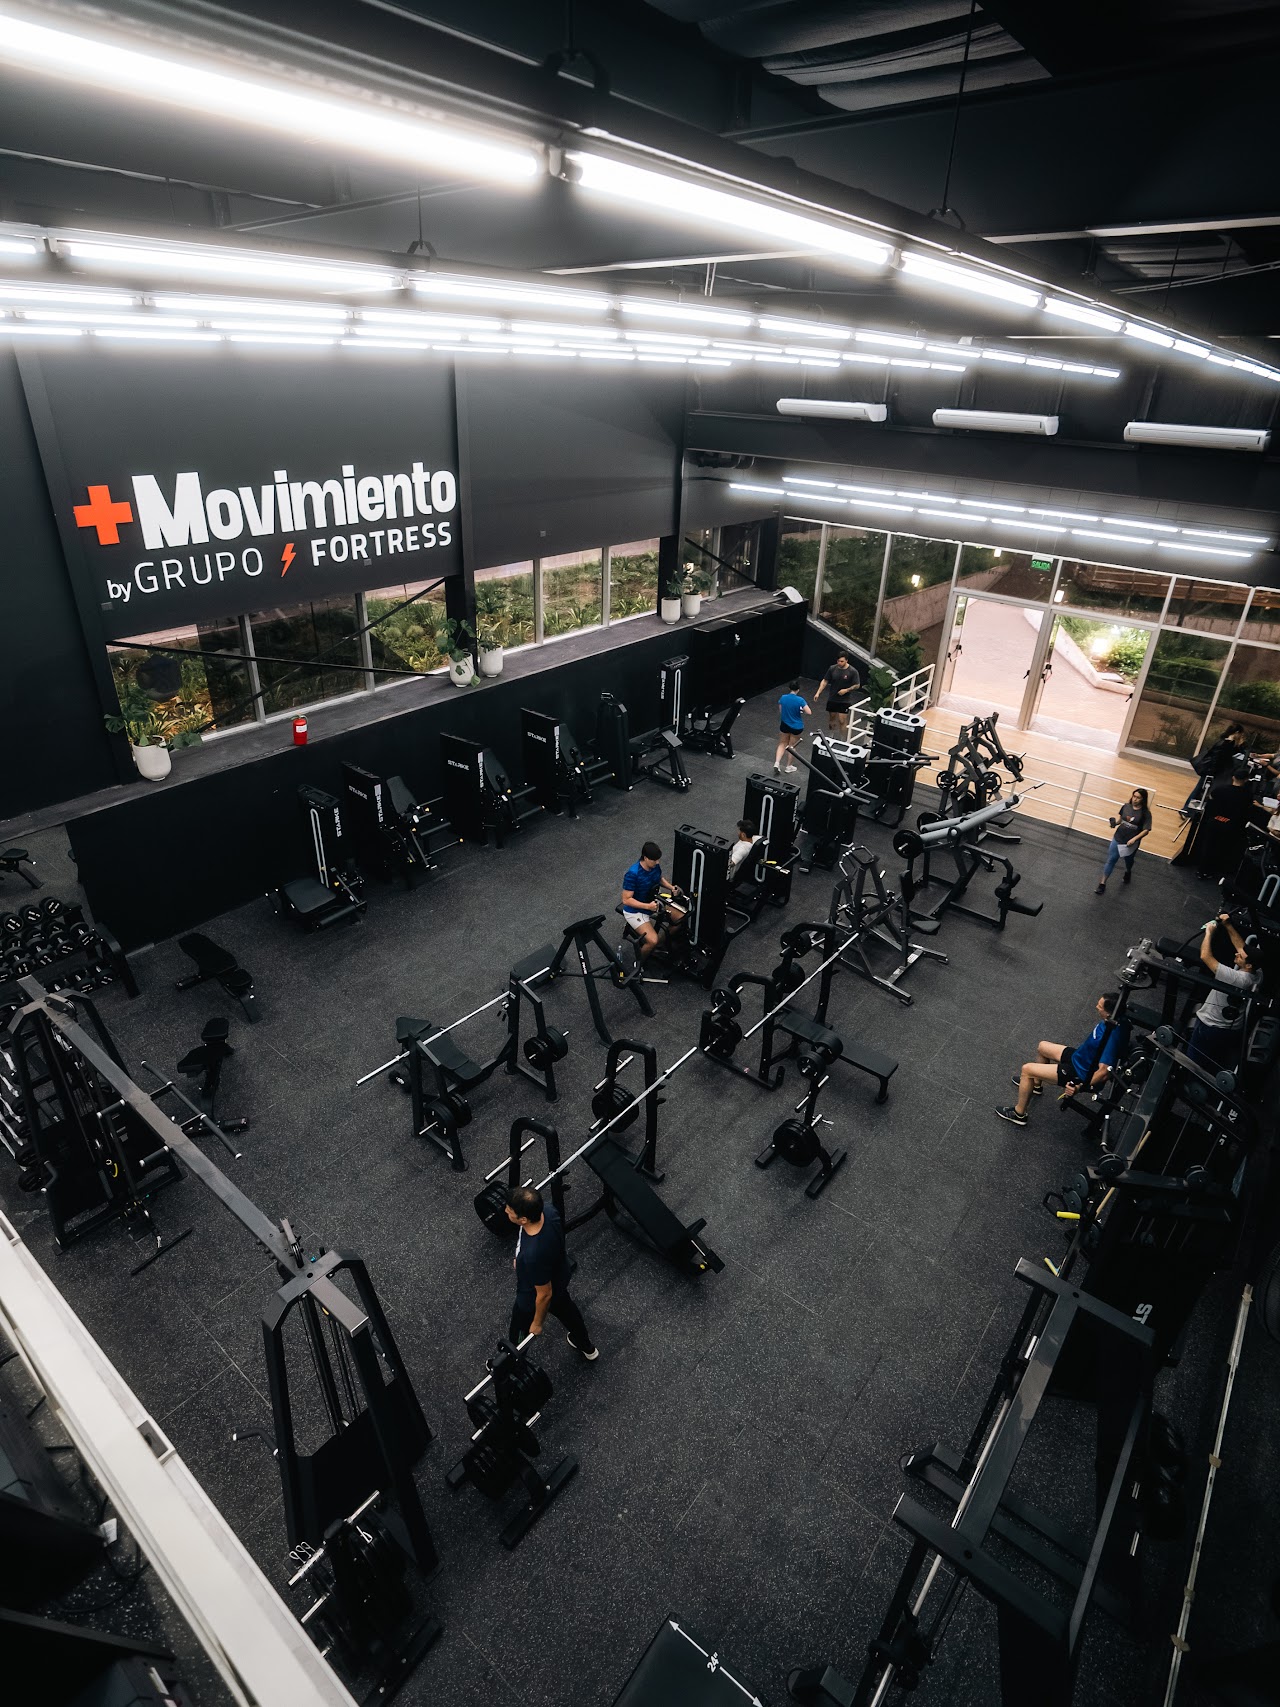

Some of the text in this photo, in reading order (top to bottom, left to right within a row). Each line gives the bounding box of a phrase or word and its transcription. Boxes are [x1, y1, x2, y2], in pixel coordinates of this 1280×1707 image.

[107, 521, 453, 603] by GRUPO FORTRESS
